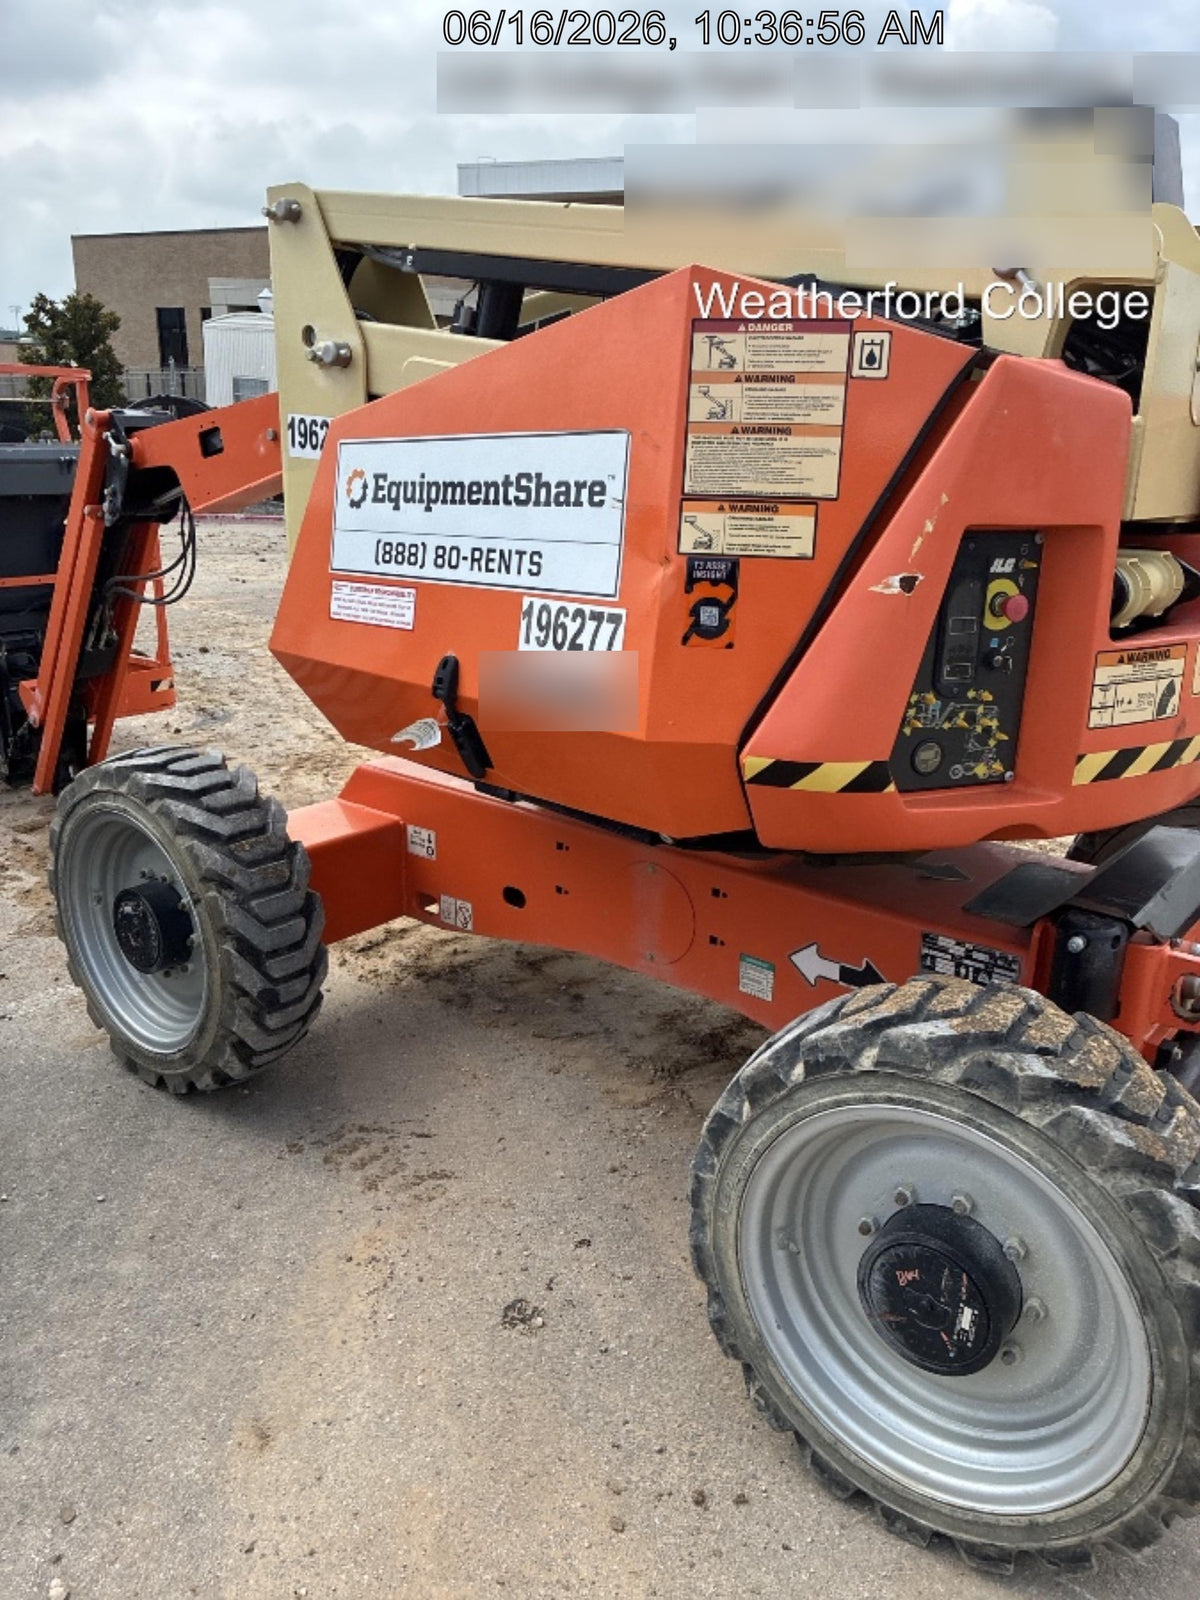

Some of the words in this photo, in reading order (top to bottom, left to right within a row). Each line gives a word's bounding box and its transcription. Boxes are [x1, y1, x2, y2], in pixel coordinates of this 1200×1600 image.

[748, 323, 793, 332] DANGER
[744, 374, 796, 384] WARNING
[740, 426, 792, 436] WARNING
[371, 472, 607, 512] EquipmentShare
[728, 504, 779, 513] WARNING
[374, 538, 427, 569] (888)
[433, 545, 543, 577] 80-RENTS
[693, 570, 726, 579] INSIGHT
[522, 600, 623, 651] 196277
